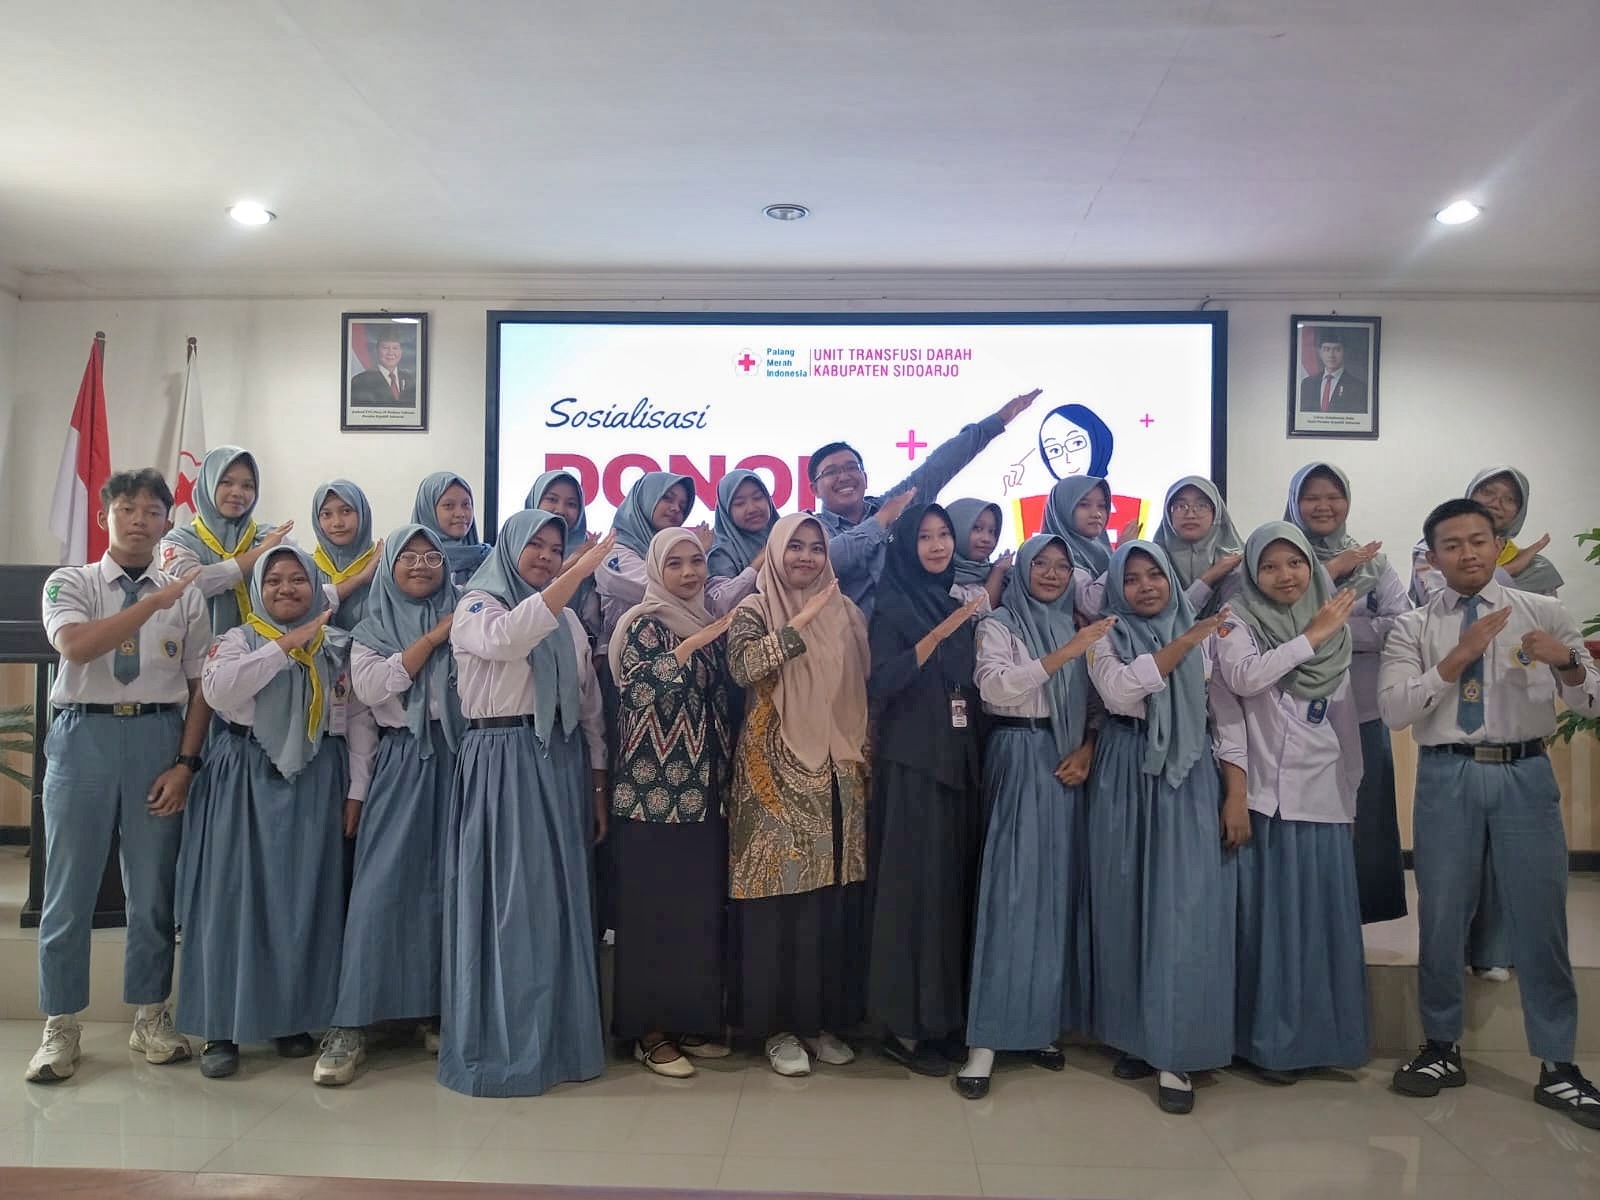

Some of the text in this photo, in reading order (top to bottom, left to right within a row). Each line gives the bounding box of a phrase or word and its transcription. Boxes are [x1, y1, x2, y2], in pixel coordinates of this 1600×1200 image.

[766, 347, 795, 358] Palang
[814, 348, 972, 361] UNIT TRANSFUSI DARAH
[766, 358, 792, 367] Merah
[766, 368, 808, 378] Indonesia
[814, 364, 959, 377] KABUPATEN SIDOARJO
[545, 396, 711, 429] Sosialisasi
